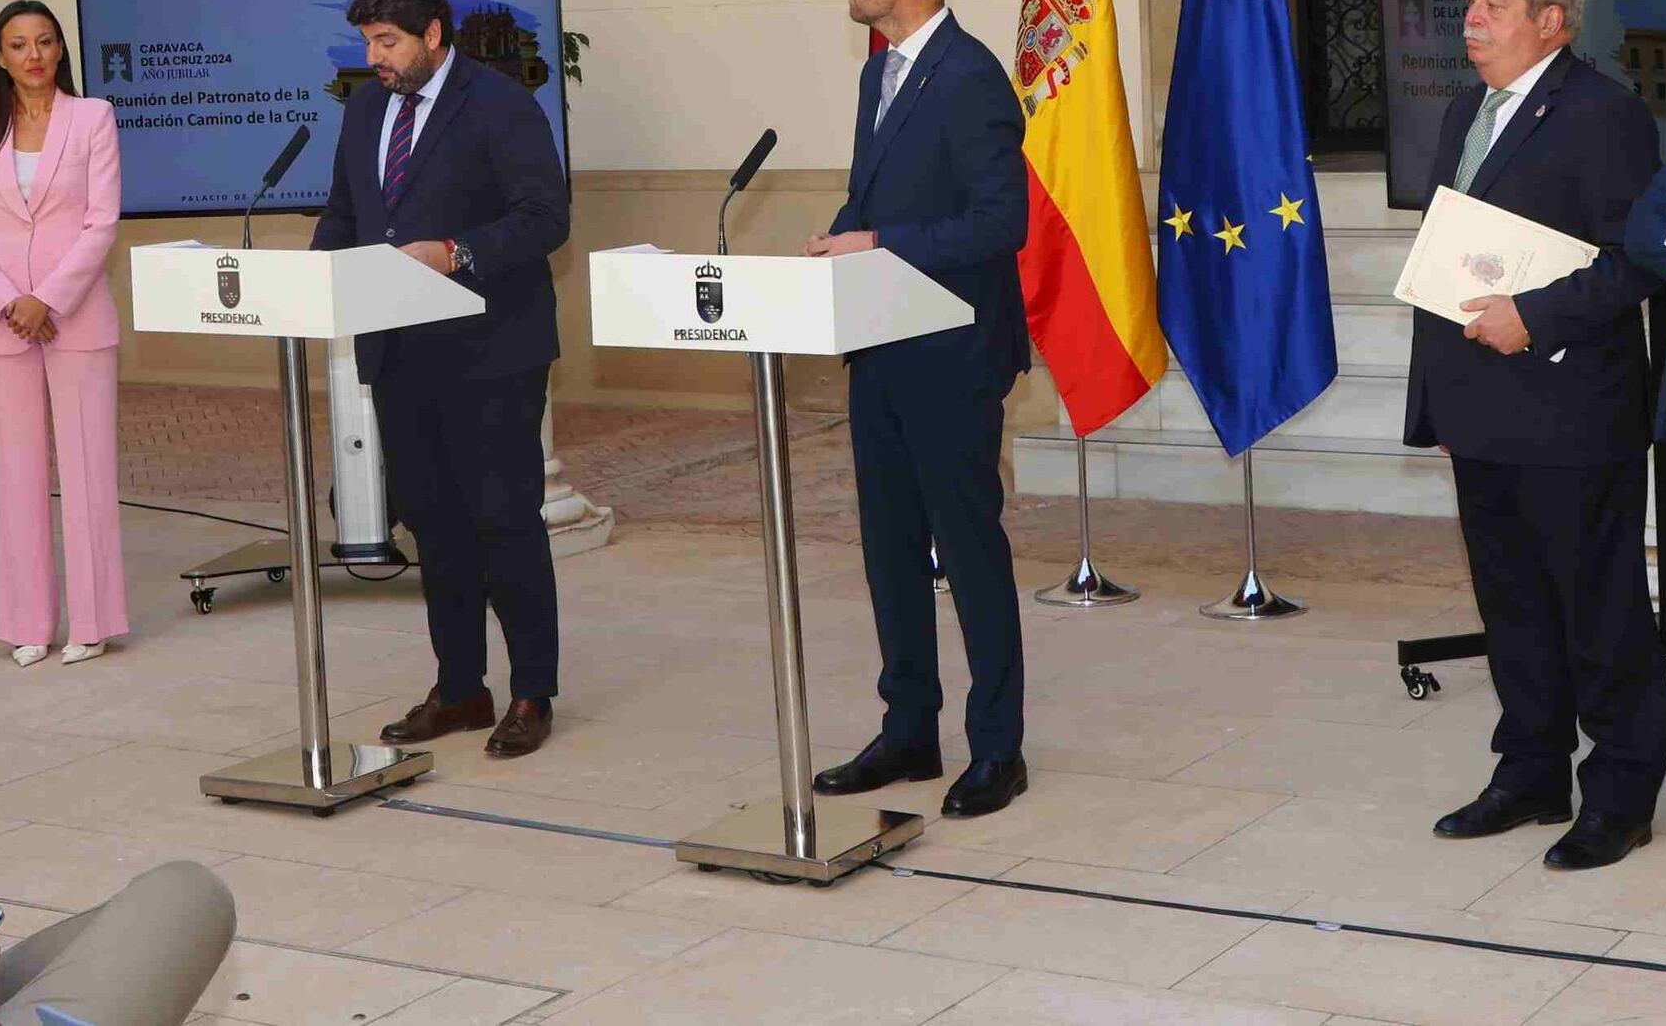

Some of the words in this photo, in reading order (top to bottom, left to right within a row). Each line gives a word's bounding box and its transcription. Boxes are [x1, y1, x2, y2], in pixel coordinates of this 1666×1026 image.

[1433, 7, 1446, 18] DE
[1447, 7, 1459, 18] LA
[139, 42, 205, 54] CARAVACA
[140, 56, 155, 67] DE
[157, 56, 171, 66] LA
[172, 54, 203, 66] CRUZ
[204, 53, 232, 64] 2024
[1402, 55, 1458, 70] Reunión
[141, 69, 165, 80] AÑO
[166, 67, 210, 81] JUBILAR
[106, 92, 167, 107] Reunión
[171, 91, 193, 105] del
[198, 90, 271, 104] Patronato
[274, 87, 293, 102] de
[296, 87, 310, 101] la
[116, 114, 183, 128] undación
[187, 111, 243, 126] Camino
[247, 110, 265, 124] de
[269, 110, 282, 123] la
[286, 109, 318, 123] Cruz
[181, 194, 229, 202] PALACIO
[235, 193, 247, 201] DE
[280, 190, 329, 199] ESTEBAN
[200, 312, 263, 326] PRESIDENCIA
[674, 328, 748, 341] PRESIDENCIA
